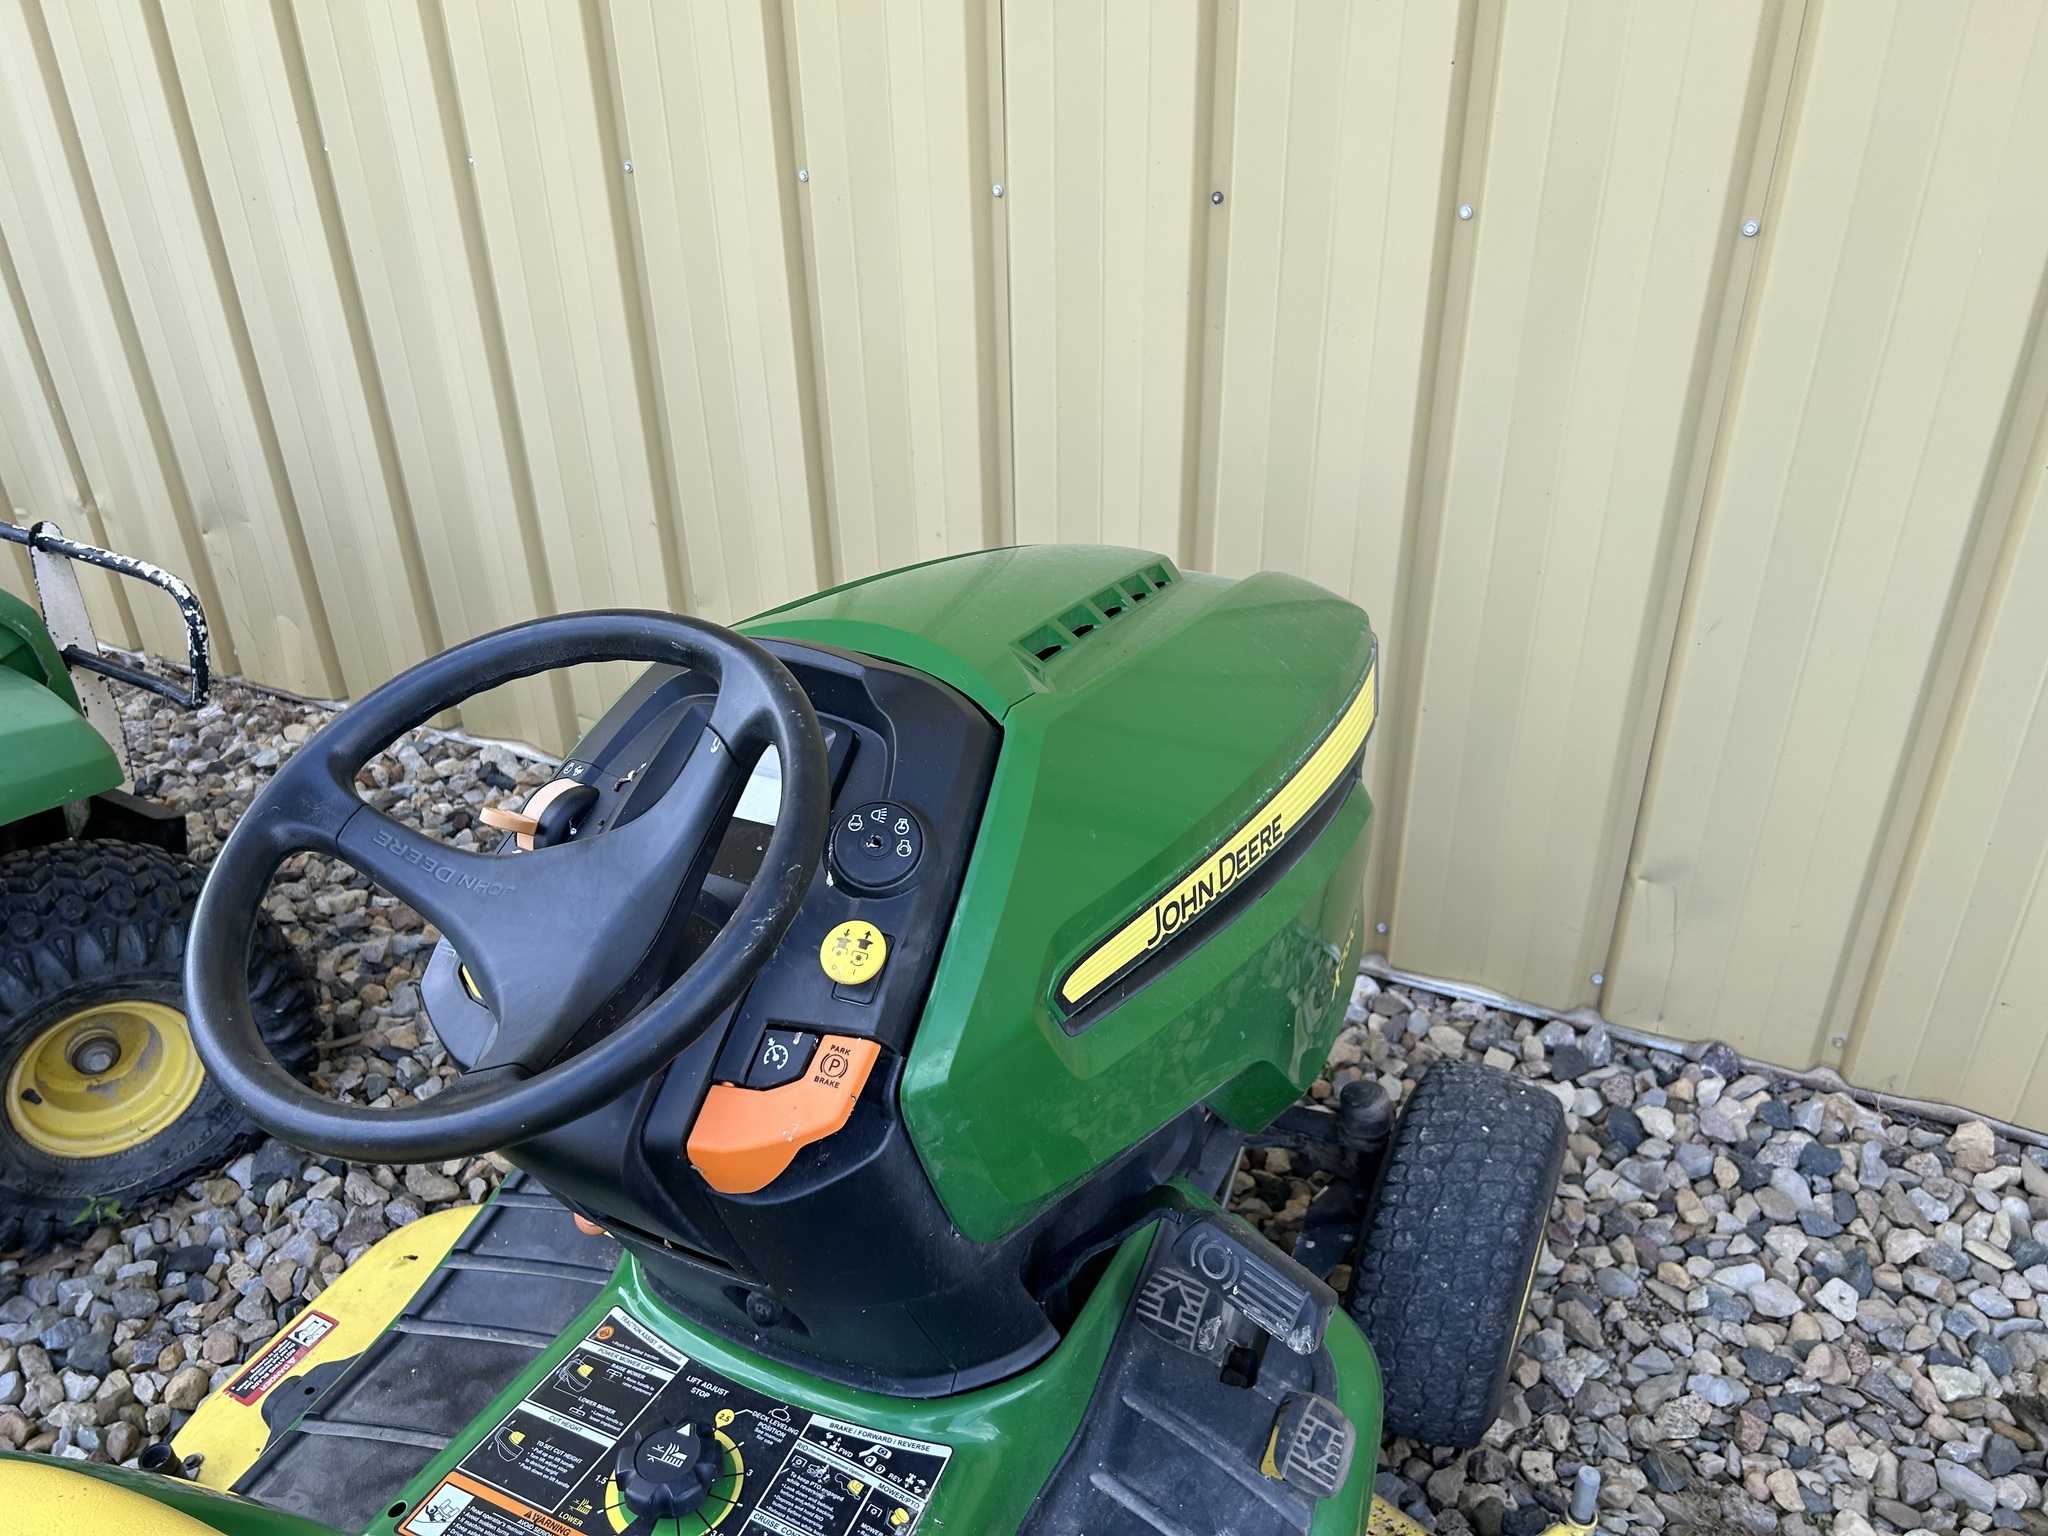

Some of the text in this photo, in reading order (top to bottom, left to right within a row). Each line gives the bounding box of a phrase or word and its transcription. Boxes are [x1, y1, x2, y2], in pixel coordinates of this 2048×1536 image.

[372, 829, 516, 900] JOHN DEERE
[1148, 814, 1284, 947] JOHN DEERE
[830, 1044, 850, 1056] PARK
[828, 1058, 840, 1072] P
[814, 1076, 840, 1088] BRAKE
[620, 1315, 641, 1334] TRACTION
[640, 1331, 658, 1346] ASSIST
[614, 1341, 625, 1350] Push
[598, 1348, 654, 1373] POWER MOWER LIFT
[250, 1349, 296, 1390] ROTATING BLADE
[610, 1363, 646, 1380] RAISE MOWER
[259, 1365, 291, 1391] DANGER
[686, 1376, 730, 1396] LIFT ADJUST
[690, 1386, 710, 1398] STOP
[578, 1396, 616, 1415] LOWER MOWER
[548, 1415, 584, 1434] CUT HEIGHT
[718, 1413, 731, 1422] 2.5
[752, 1410, 800, 1436] DECK LEVELING
[754, 1428, 783, 1443] See manual
[758, 1422, 786, 1438] POSITION
[829, 1422, 853, 1434] BRAKE
[858, 1430, 892, 1444] FORWARD
[898, 1440, 930, 1452] REVERSE
[796, 1442, 808, 1450] RIO
[838, 1447, 854, 1458] FWD
[544, 1444, 554, 1452] SET
[554, 1448, 564, 1458] CUT
[564, 1452, 583, 1464] HEIGHT
[595, 1474, 608, 1484] 1.5
[786, 1478, 800, 1486] while
[796, 1475, 810, 1484] keep
[810, 1481, 822, 1490] PTO
[888, 1472, 902, 1483] REV
[794, 1490, 808, 1498] down
[878, 1482, 920, 1510] MOWER/PTO
[780, 1489, 794, 1499] before
[816, 1507, 834, 1520] backing
[464, 1512, 480, 1522] Avoid
[478, 1519, 496, 1530] sudden
[470, 1506, 484, 1514] Read
[506, 1524, 525, 1536] manual
[517, 1519, 534, 1530] AVOID
[532, 1512, 571, 1536] WARNING
[559, 1511, 584, 1526] LOWER
[754, 1513, 780, 1530] CRUISE
[801, 1516, 824, 1530] reversing
[814, 1514, 824, 1522] RIO
[454, 1522, 468, 1532] Keep
[464, 1520, 484, 1532] machine
